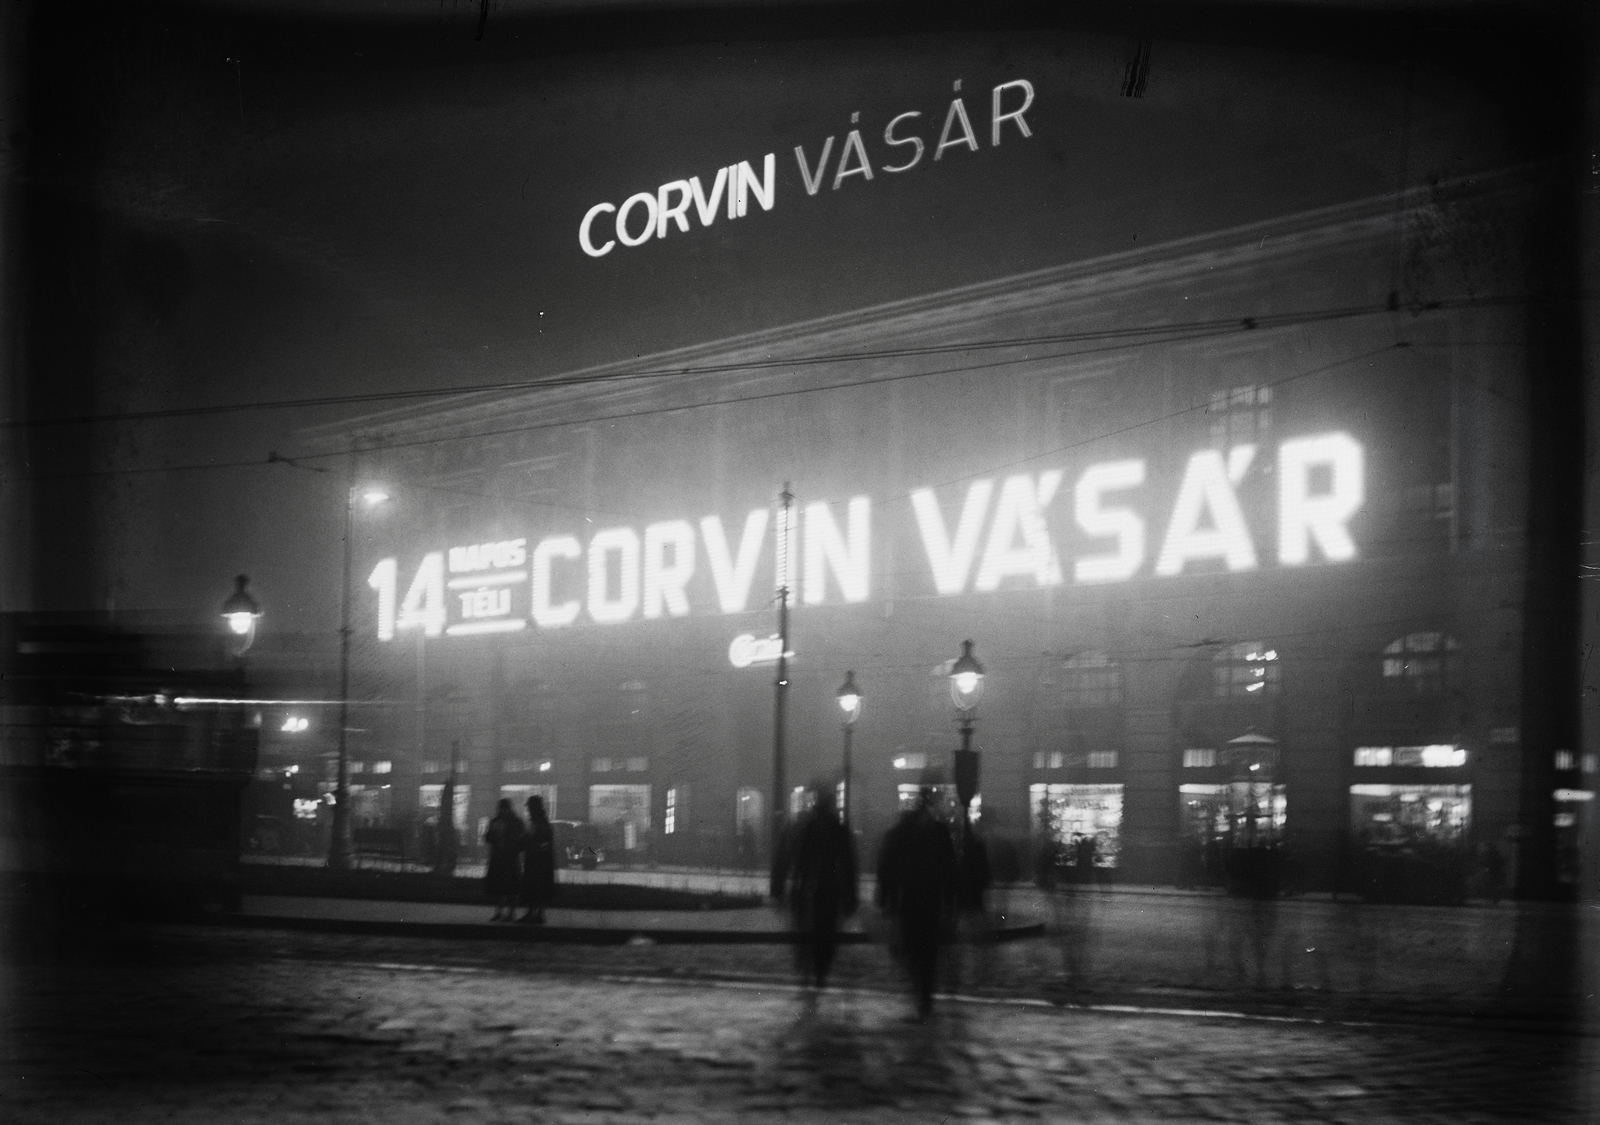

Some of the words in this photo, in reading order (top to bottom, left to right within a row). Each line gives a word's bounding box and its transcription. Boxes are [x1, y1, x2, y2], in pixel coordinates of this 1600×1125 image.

[578, 153, 776, 258] CORVIN
[794, 79, 1035, 196] VÁSÁR
[368, 552, 446, 640] 14
[532, 496, 873, 627] CORVIN
[911, 432, 1363, 595] VÁSÁR
